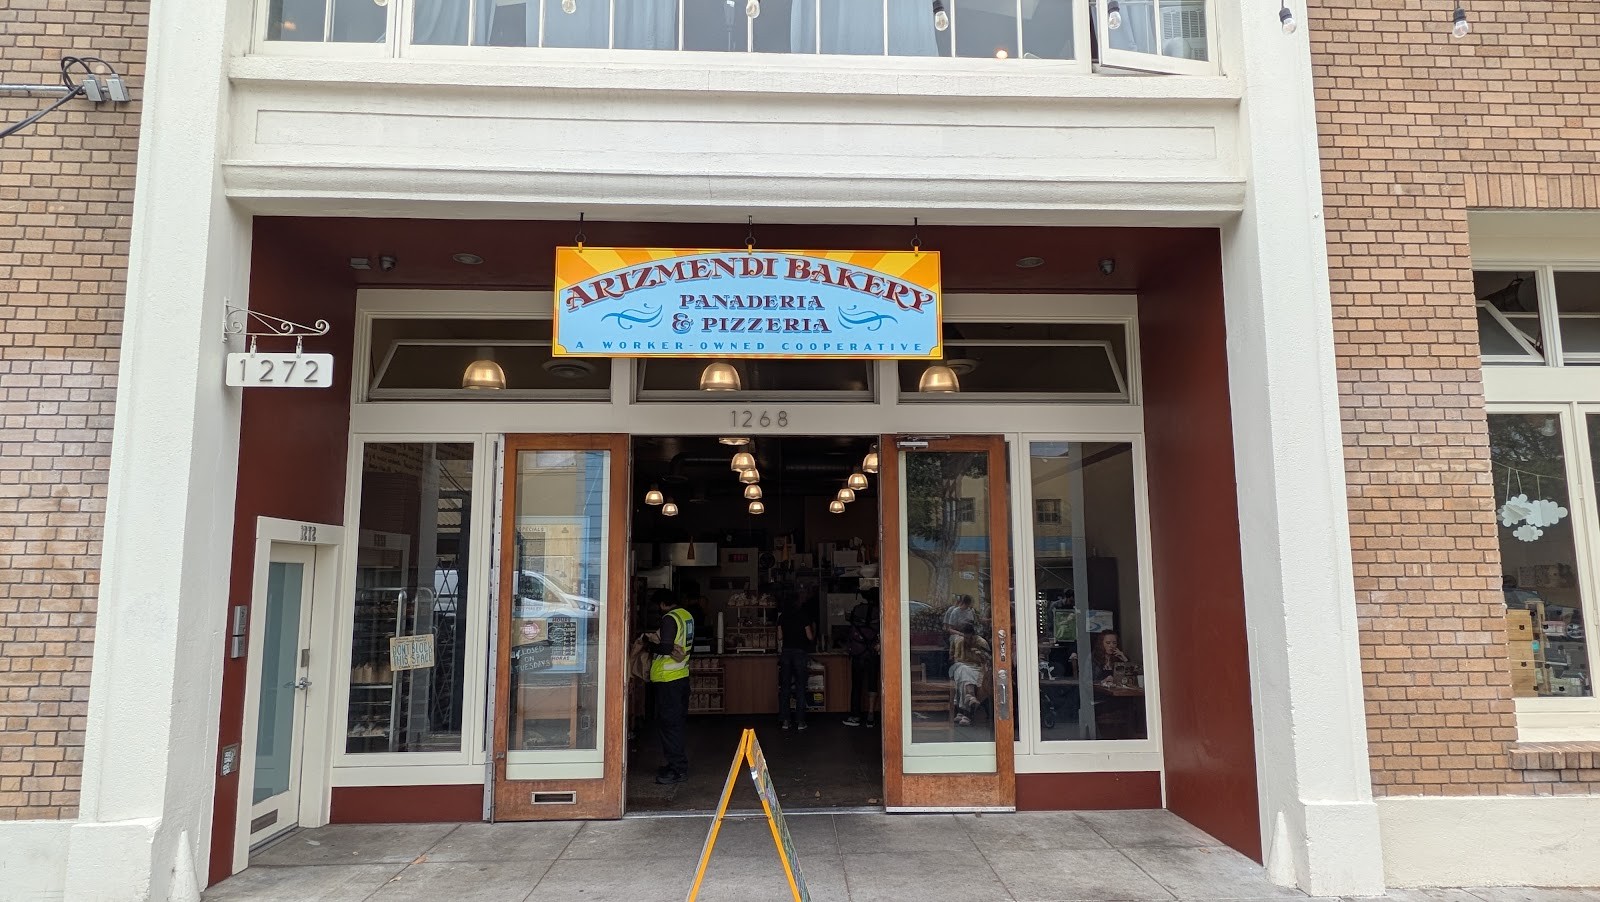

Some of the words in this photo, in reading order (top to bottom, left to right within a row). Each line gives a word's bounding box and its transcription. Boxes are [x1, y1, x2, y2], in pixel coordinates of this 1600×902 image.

[566, 257, 777, 313] ARIZMENDI
[785, 257, 933, 314] BAKERY
[679, 294, 825, 311] PANADERIA
[671, 313, 694, 334] &
[700, 317, 832, 333] PIZZERIA
[575, 341, 585, 350] A
[602, 341, 766, 352] WORKER-OWNED
[781, 342, 923, 352] COOPERATIVE
[239, 358, 319, 383] 1272
[731, 410, 788, 427] 1268
[300, 524, 317, 541] 1272
[412, 641, 432, 653] BLOCK
[392, 654, 409, 666] THIS
[411, 652, 432, 664] SPACE
[515, 660, 551, 673] TUESDAYS
[524, 655, 535, 663] ON
